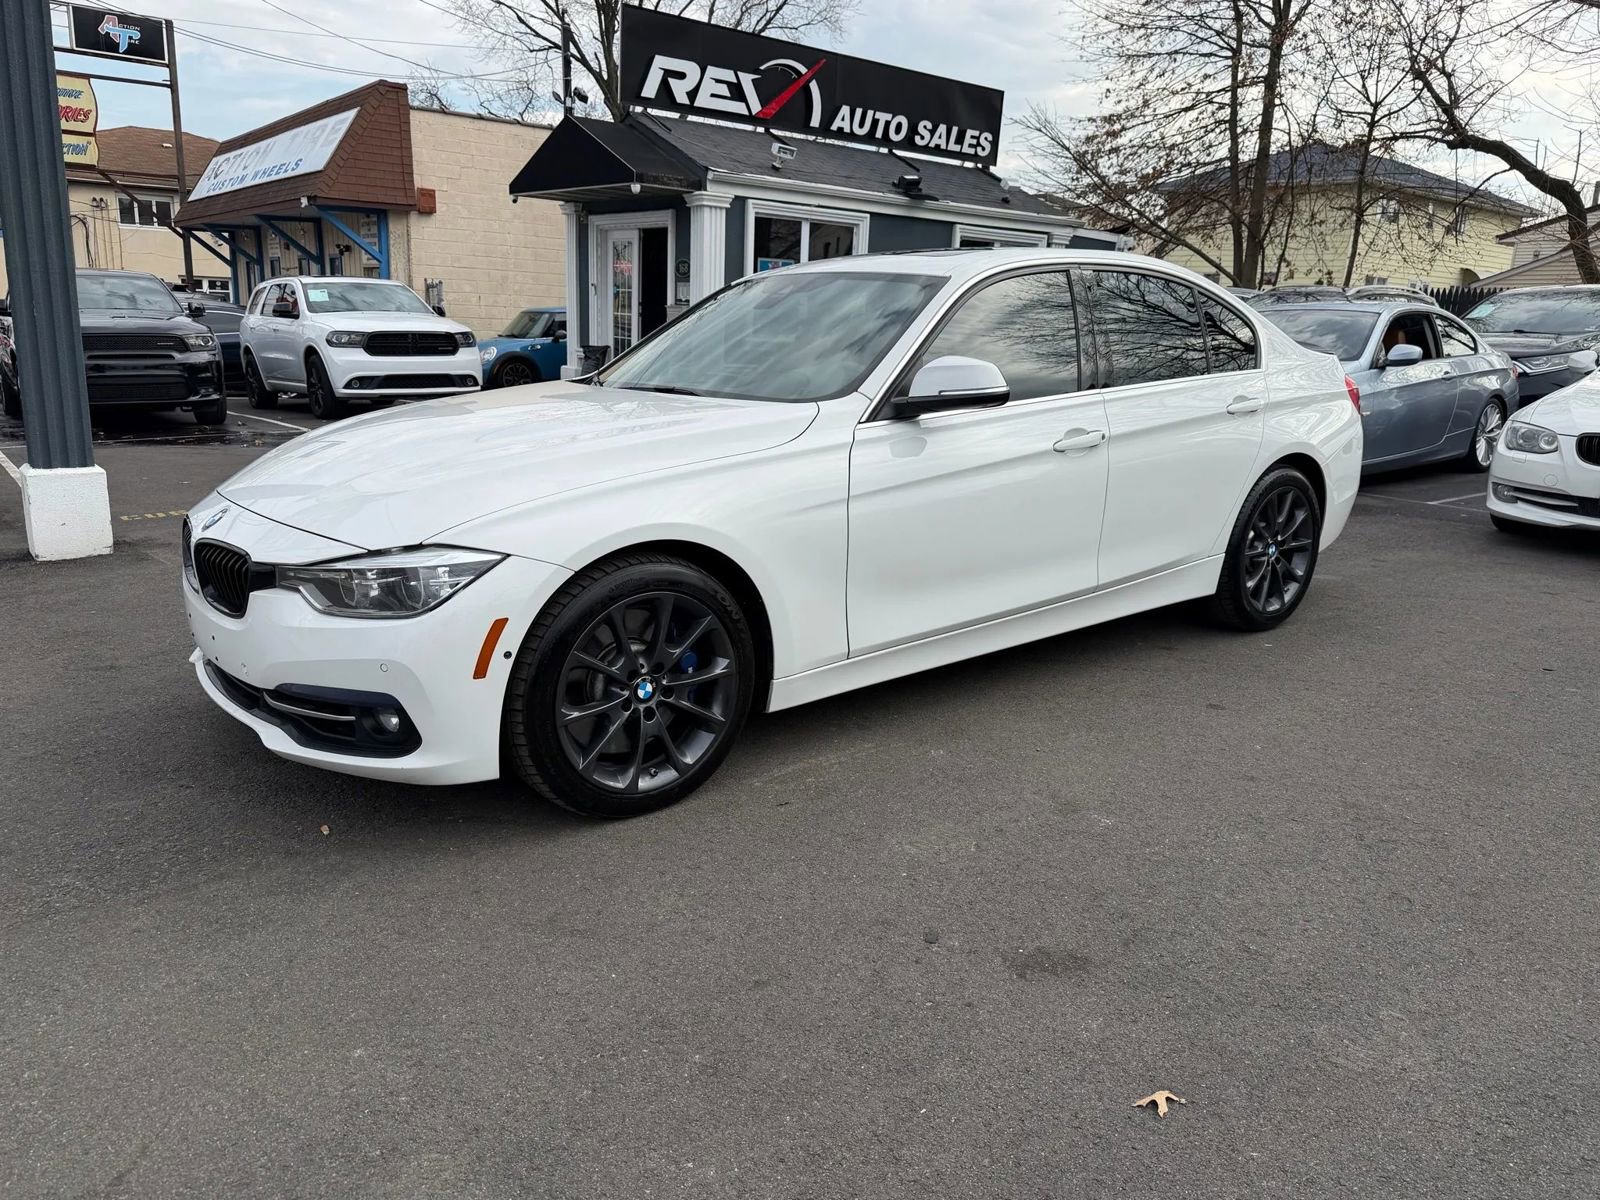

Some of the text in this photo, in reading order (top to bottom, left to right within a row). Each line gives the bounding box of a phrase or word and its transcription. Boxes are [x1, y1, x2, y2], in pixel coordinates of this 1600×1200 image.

[830, 105, 993, 157] AUTO SALES
[206, 158, 303, 193] CUSTOM WHEELS
